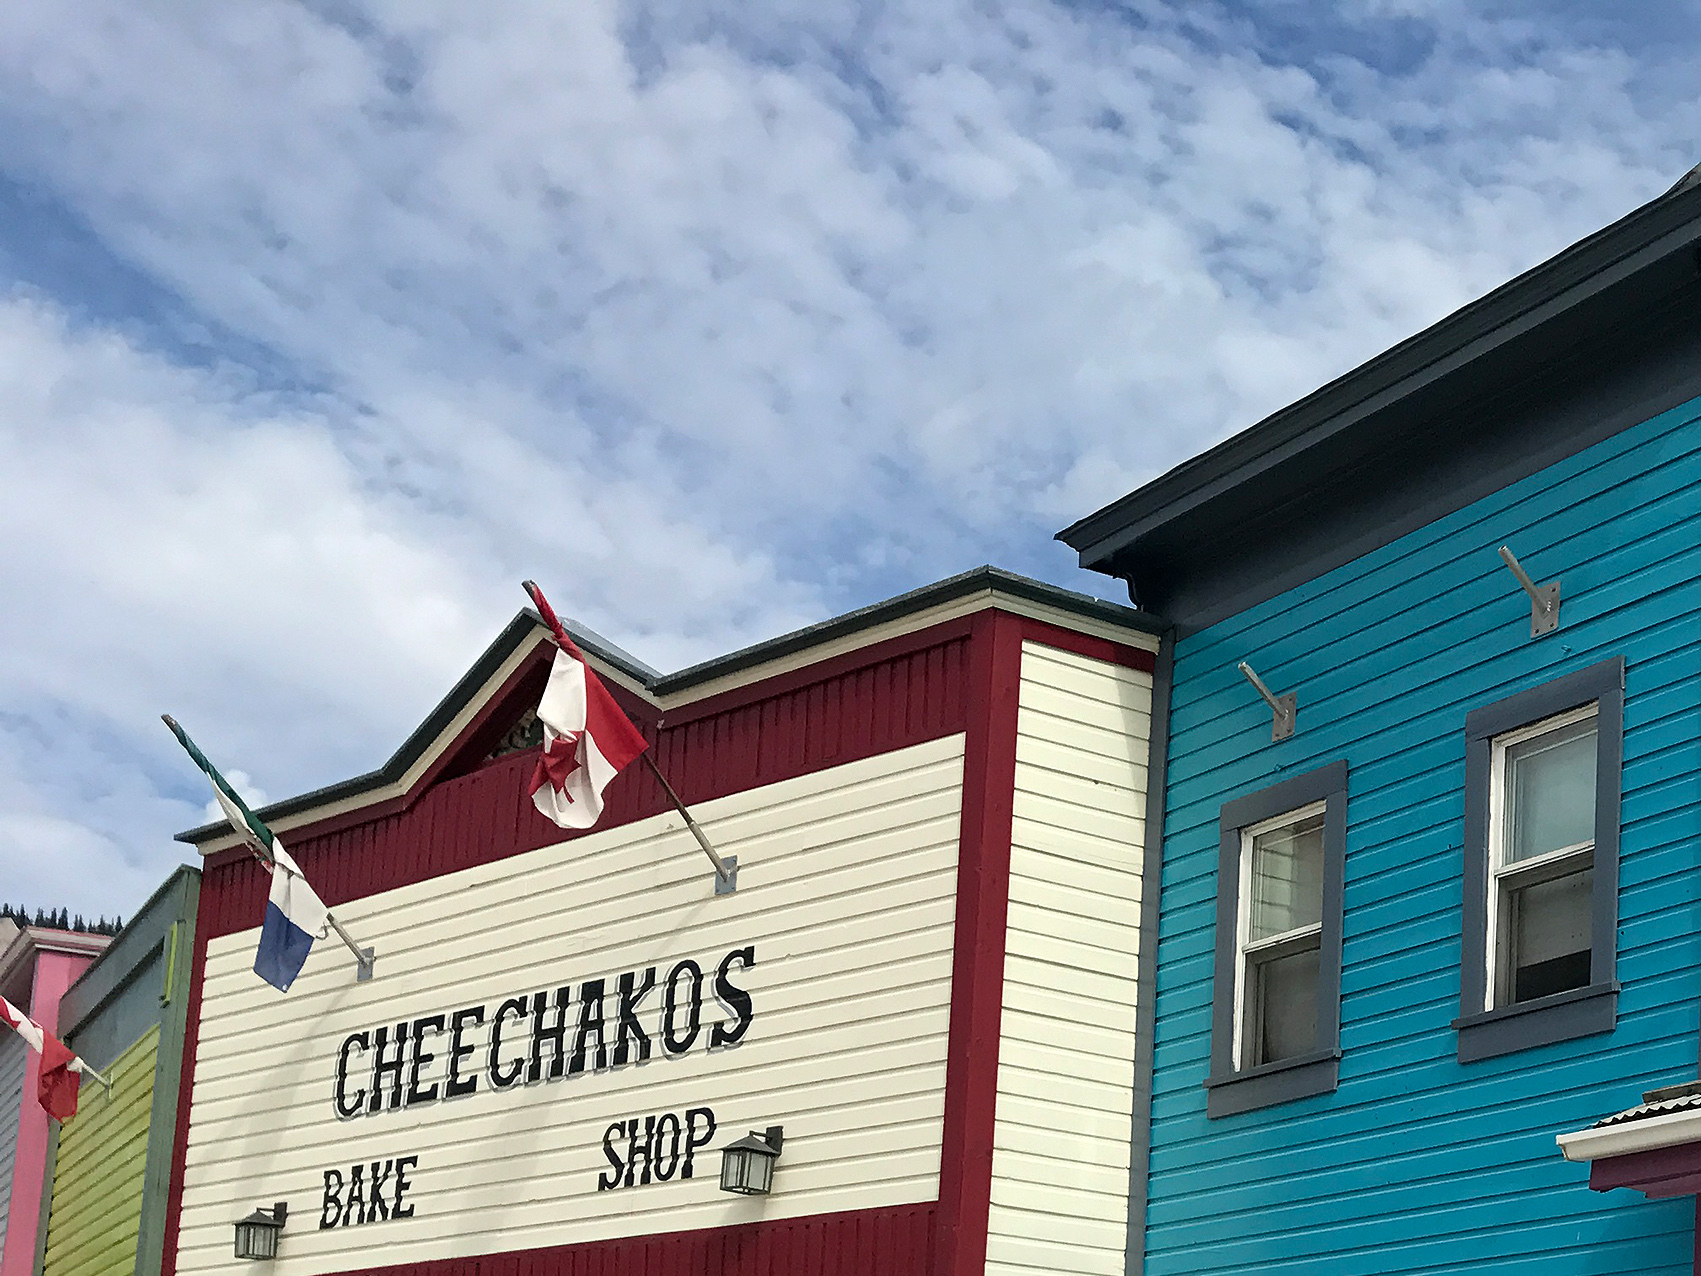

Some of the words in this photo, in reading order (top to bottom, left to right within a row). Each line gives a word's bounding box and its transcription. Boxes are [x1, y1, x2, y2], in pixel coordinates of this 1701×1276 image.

[335, 946, 756, 1121] CHEECHAKOS
[319, 1155, 418, 1230] BAKE
[599, 1107, 717, 1190] SHOP
